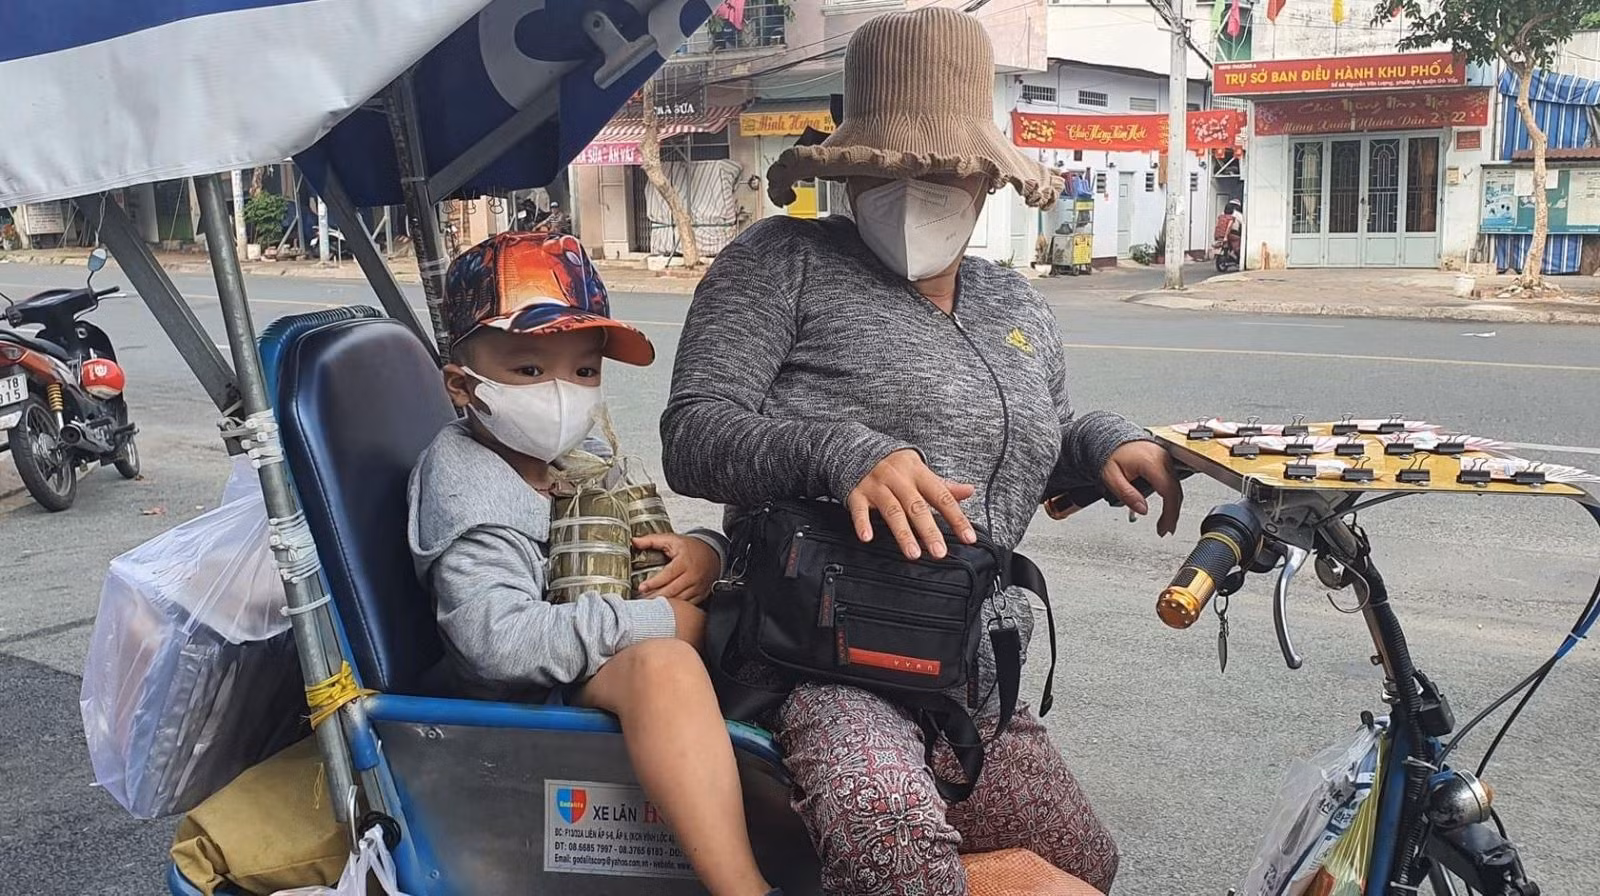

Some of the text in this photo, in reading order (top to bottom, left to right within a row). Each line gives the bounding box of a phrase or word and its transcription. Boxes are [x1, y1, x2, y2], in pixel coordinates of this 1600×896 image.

[1225, 59, 1454, 87] TRỤ SỞ BAN ĐIỀU HÀNH KHU PHỐ 4
[1065, 124, 1089, 141] Chúc
[593, 805, 609, 821] XE
[613, 803, 637, 822] LĂN
[554, 842, 567, 851] ĐT:
[554, 853, 571, 863] Email:
